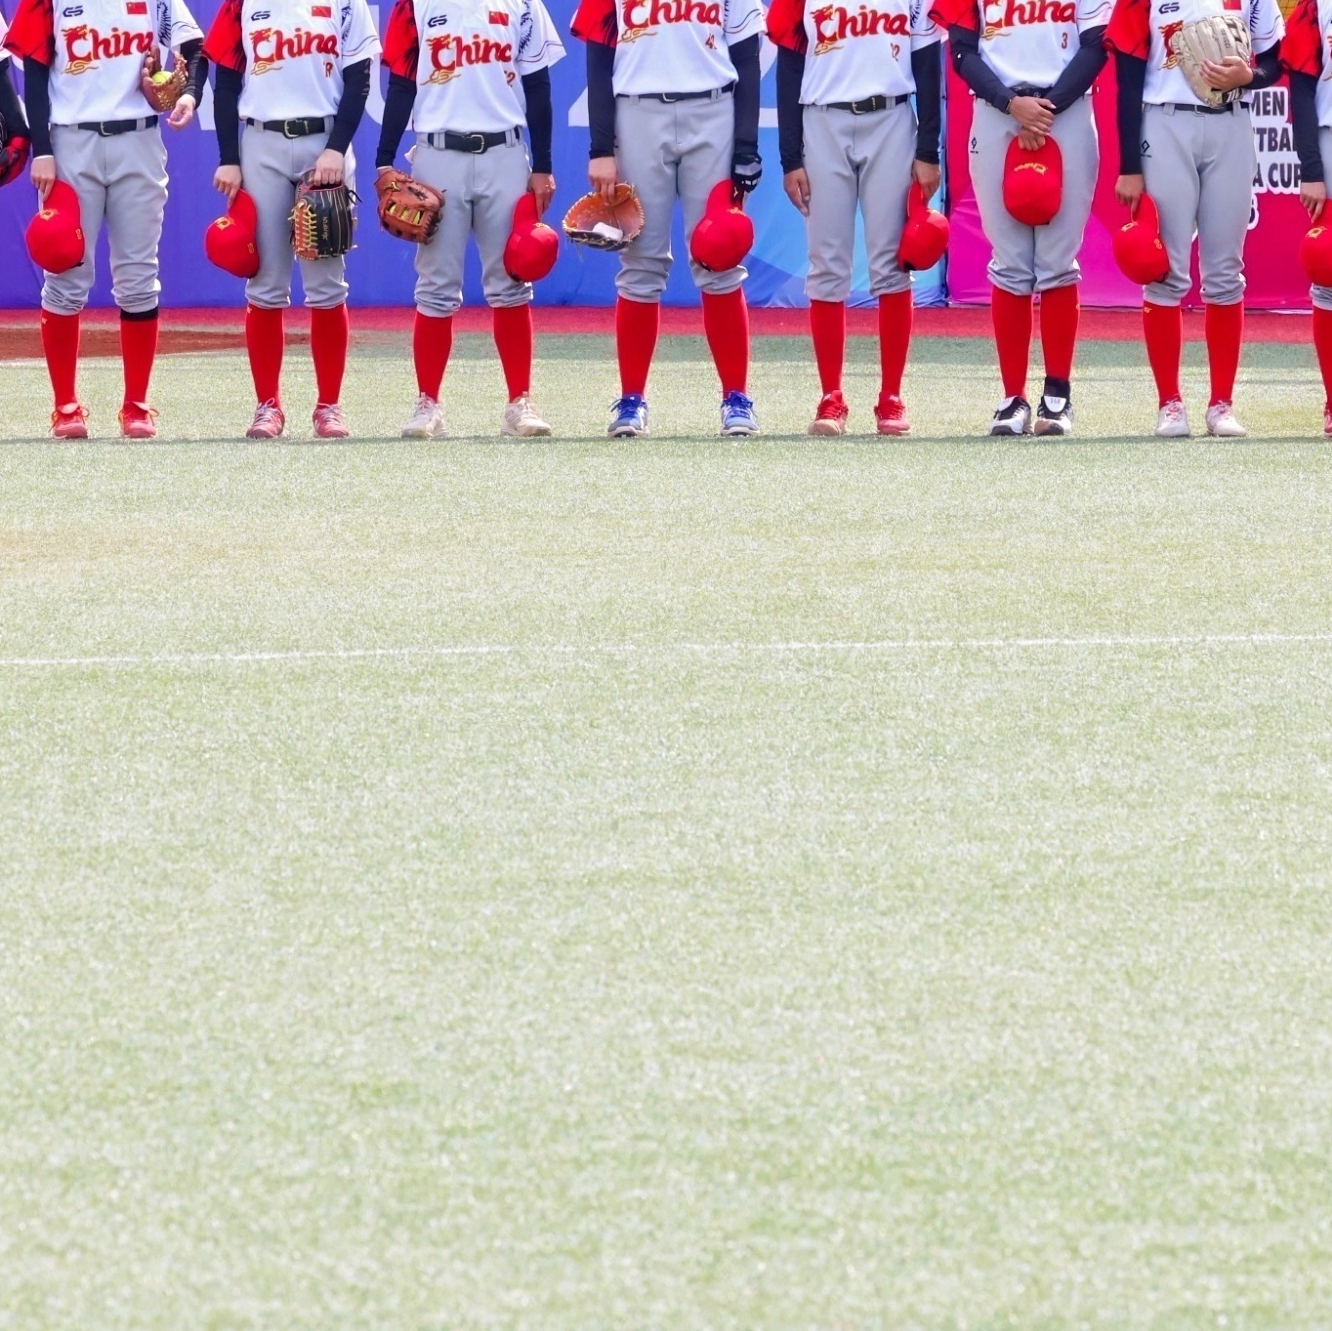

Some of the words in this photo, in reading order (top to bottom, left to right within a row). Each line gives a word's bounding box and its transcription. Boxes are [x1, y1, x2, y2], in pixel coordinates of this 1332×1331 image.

[810, 4, 911, 43] China
[1061, 32, 1068, 49] 3
[250, 28, 339, 63] China
